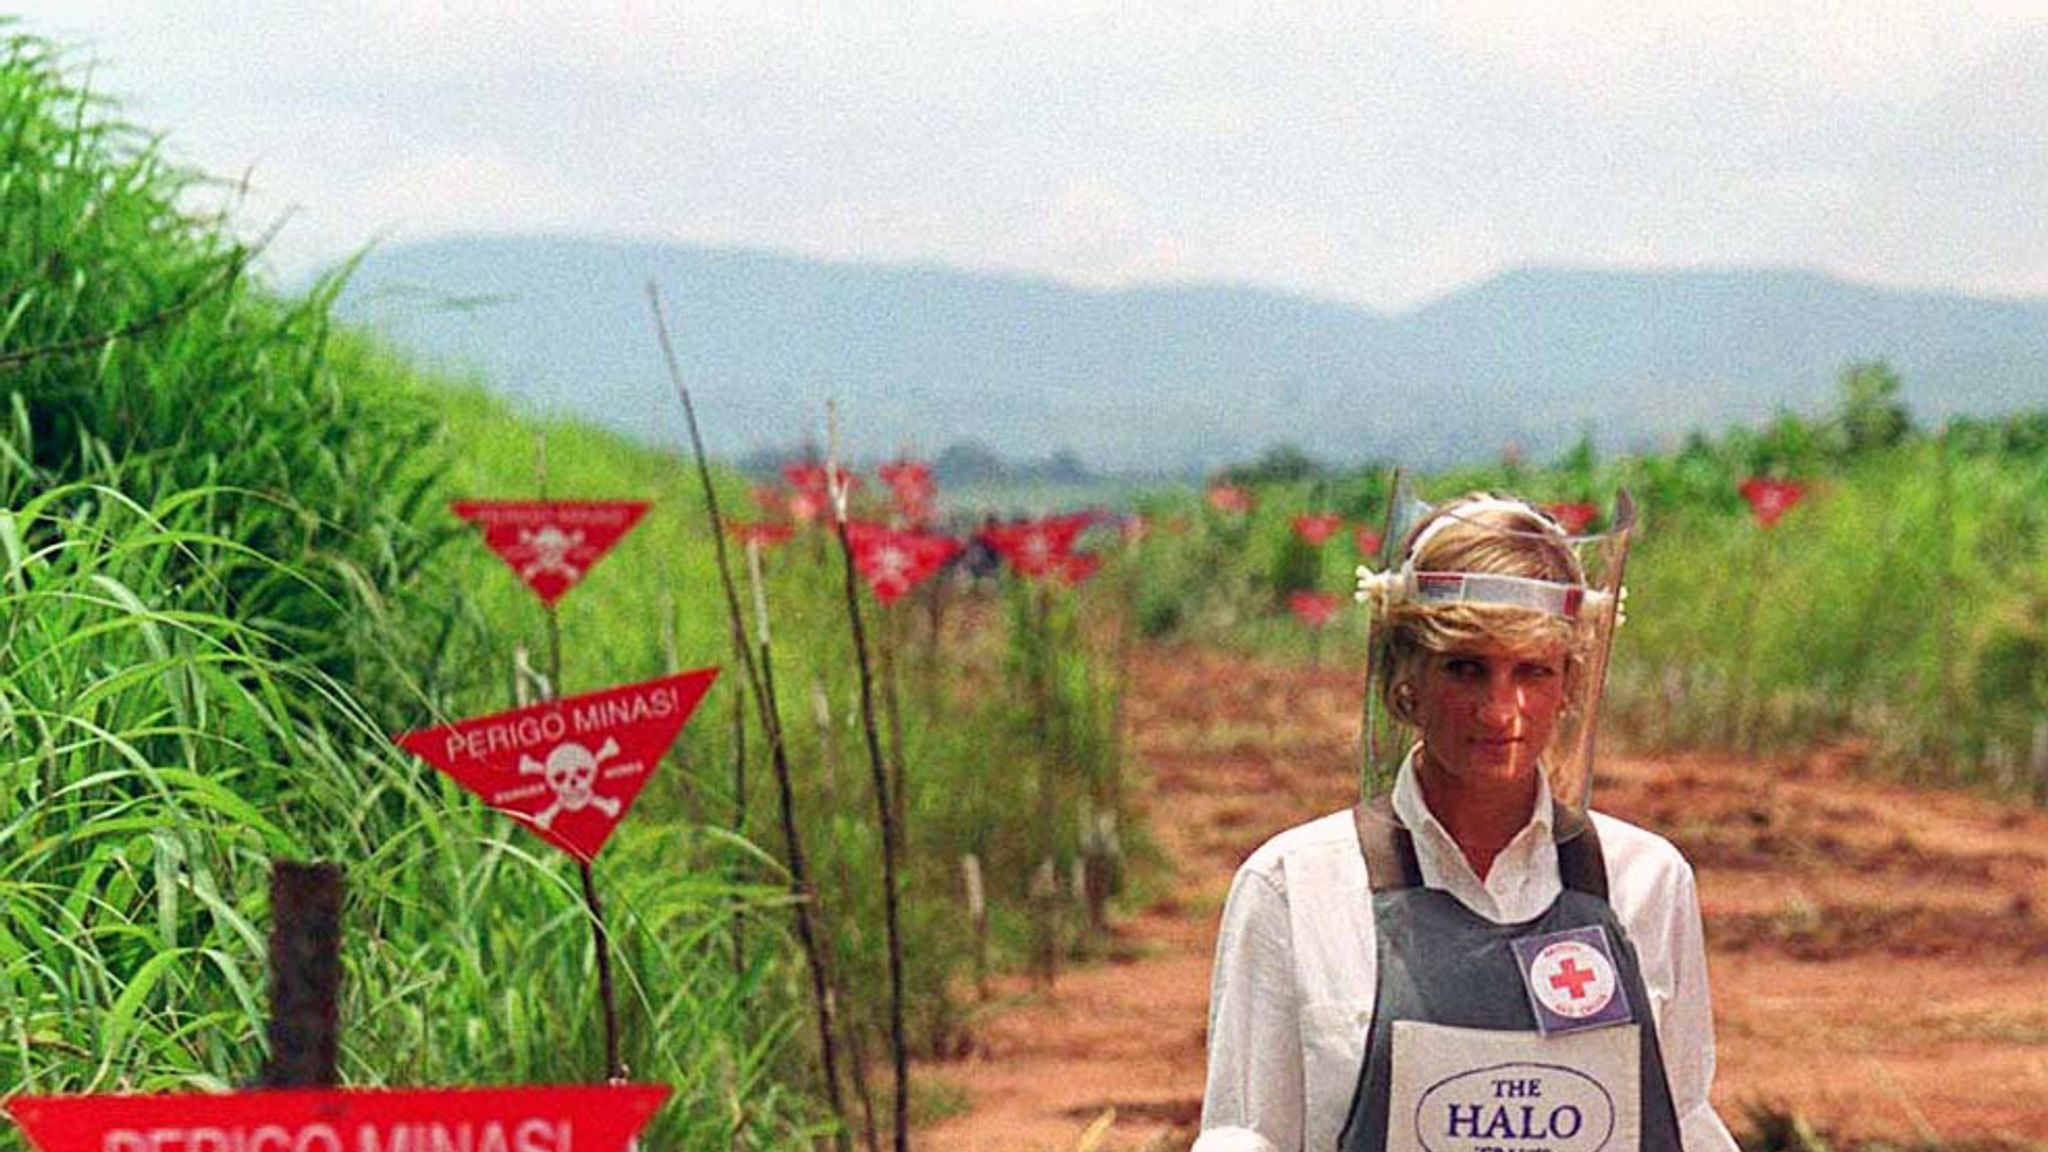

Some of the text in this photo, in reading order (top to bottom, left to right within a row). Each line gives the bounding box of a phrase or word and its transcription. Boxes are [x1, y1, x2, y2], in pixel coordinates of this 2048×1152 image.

[446, 711, 565, 763] PERIGO
[1491, 1078, 1542, 1098] THE
[1447, 1105, 1582, 1138] HALO
